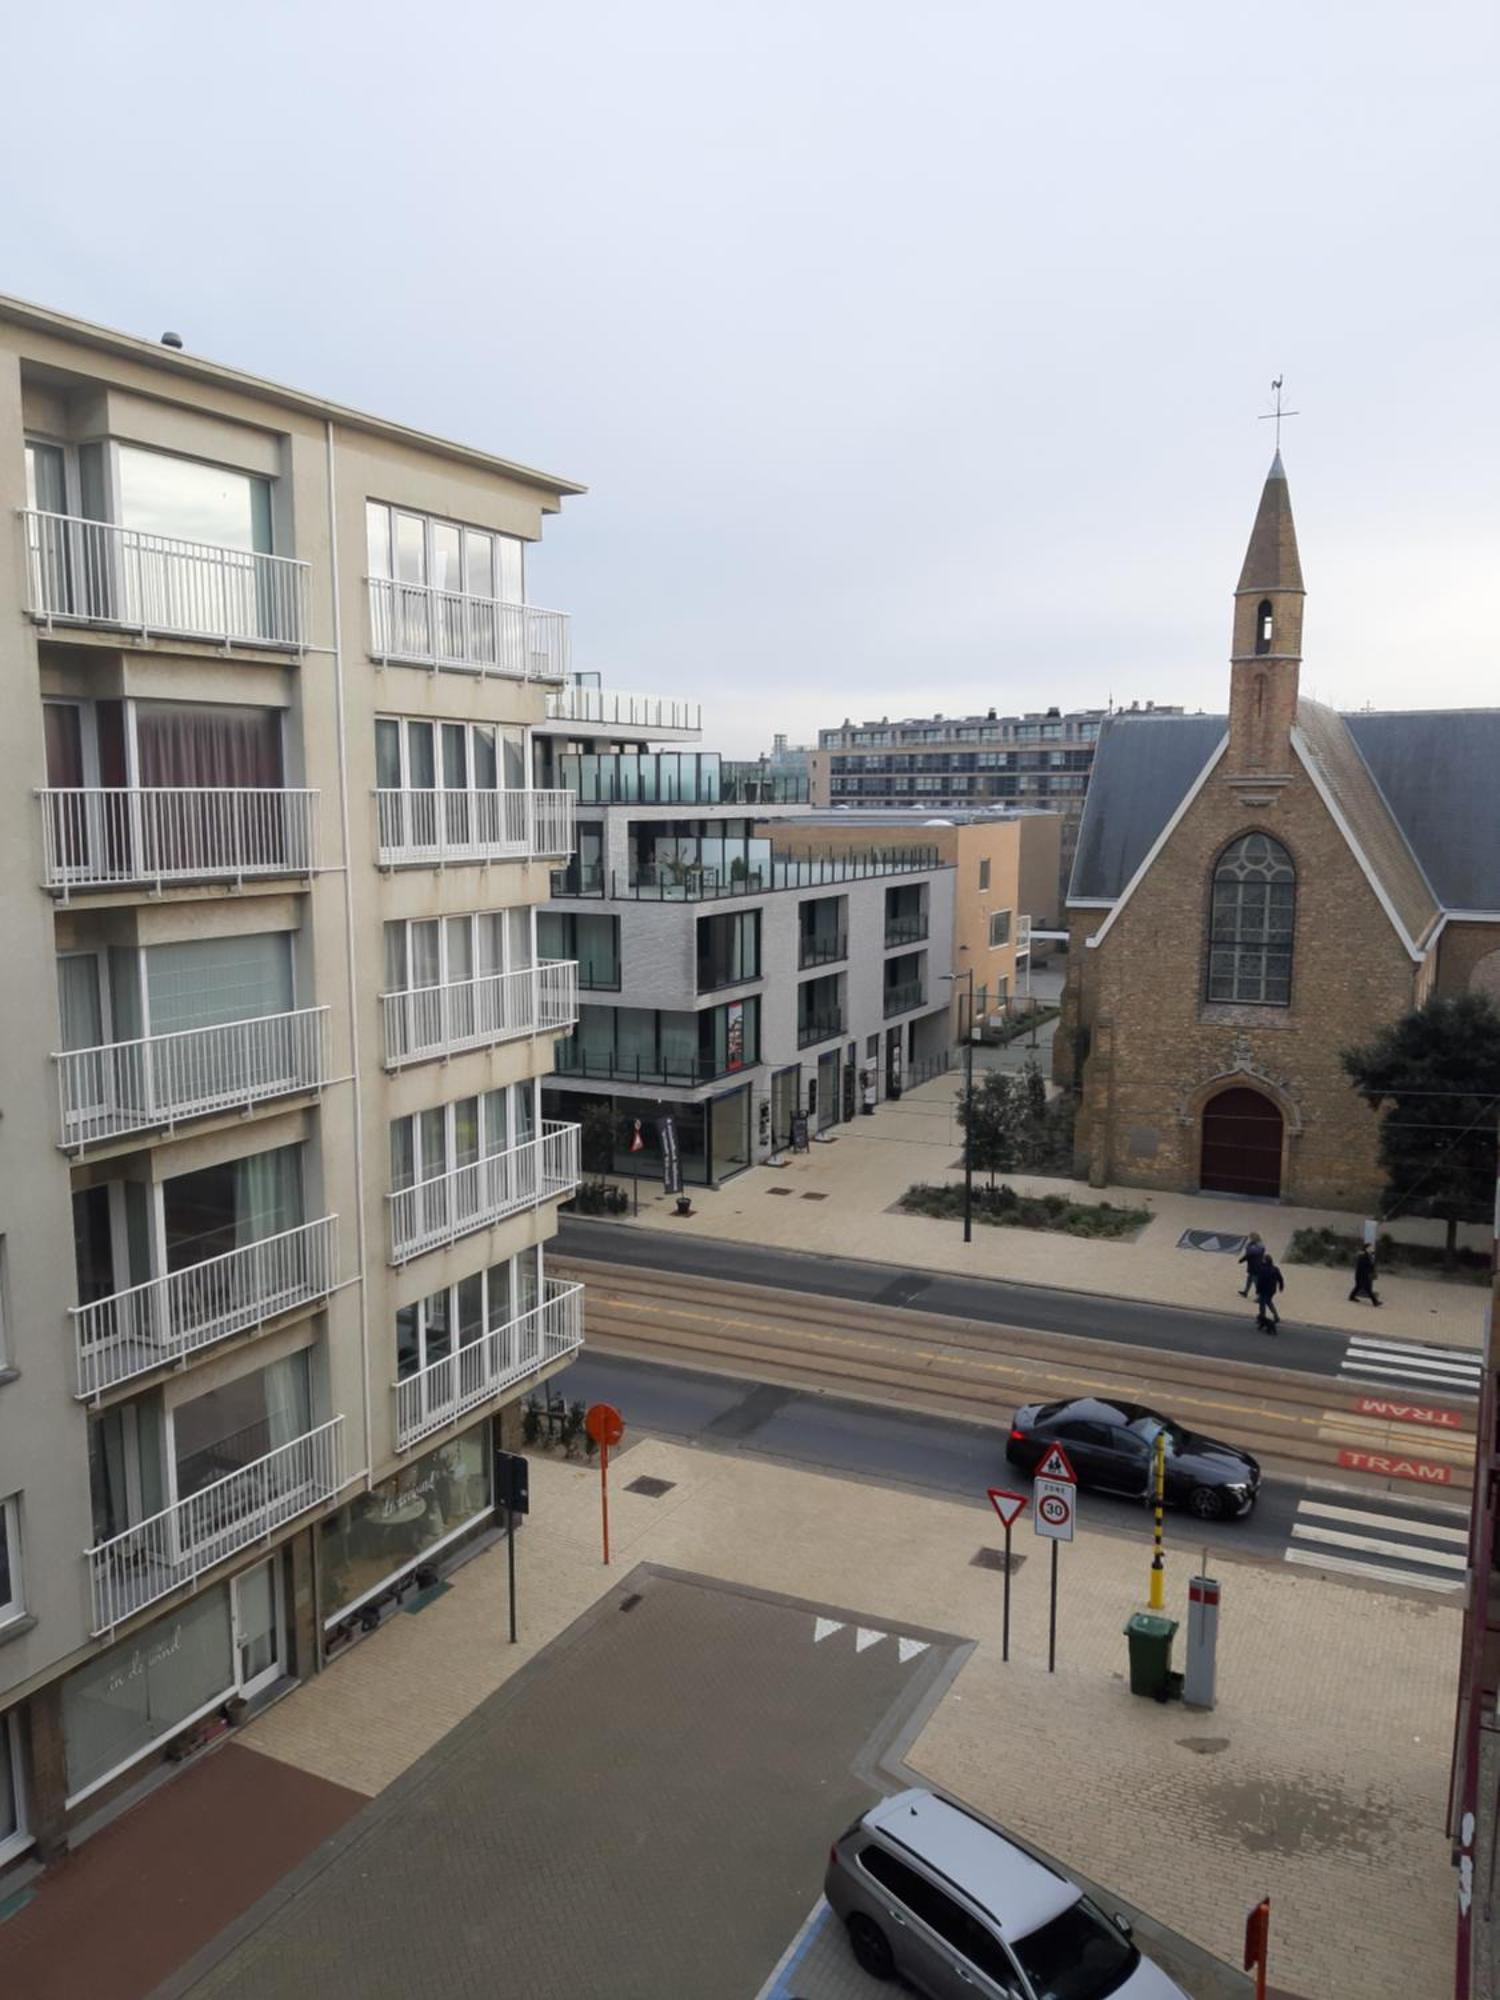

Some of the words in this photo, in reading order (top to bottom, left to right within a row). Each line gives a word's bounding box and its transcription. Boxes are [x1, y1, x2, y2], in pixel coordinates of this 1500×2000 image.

[1362, 1400, 1454, 1425] TRAM
[1345, 1453, 1445, 1480] TRAM
[1046, 1503, 1062, 1516] 30
